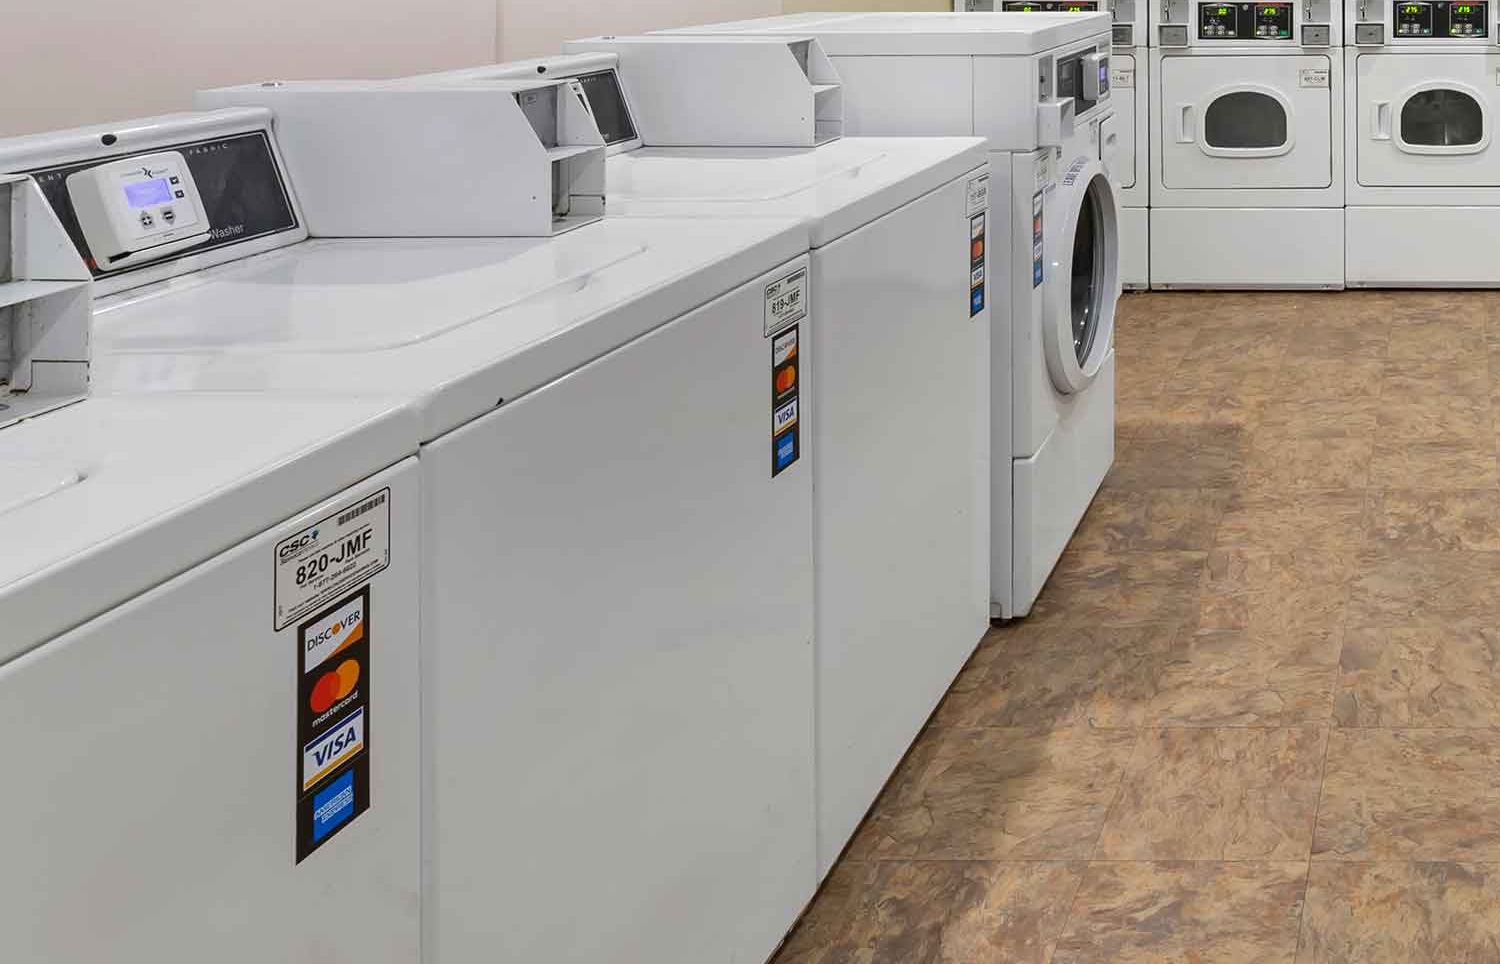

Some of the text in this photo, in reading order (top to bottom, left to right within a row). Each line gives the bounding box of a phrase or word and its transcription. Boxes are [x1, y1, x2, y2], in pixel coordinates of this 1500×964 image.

[777, 406, 795, 425] VISA
[279, 535, 310, 558] CSC
[295, 528, 374, 585] 820-JMF
[307, 609, 361, 652] DISCOVER
[312, 689, 359, 728] mastercard
[312, 726, 356, 767] VISA
